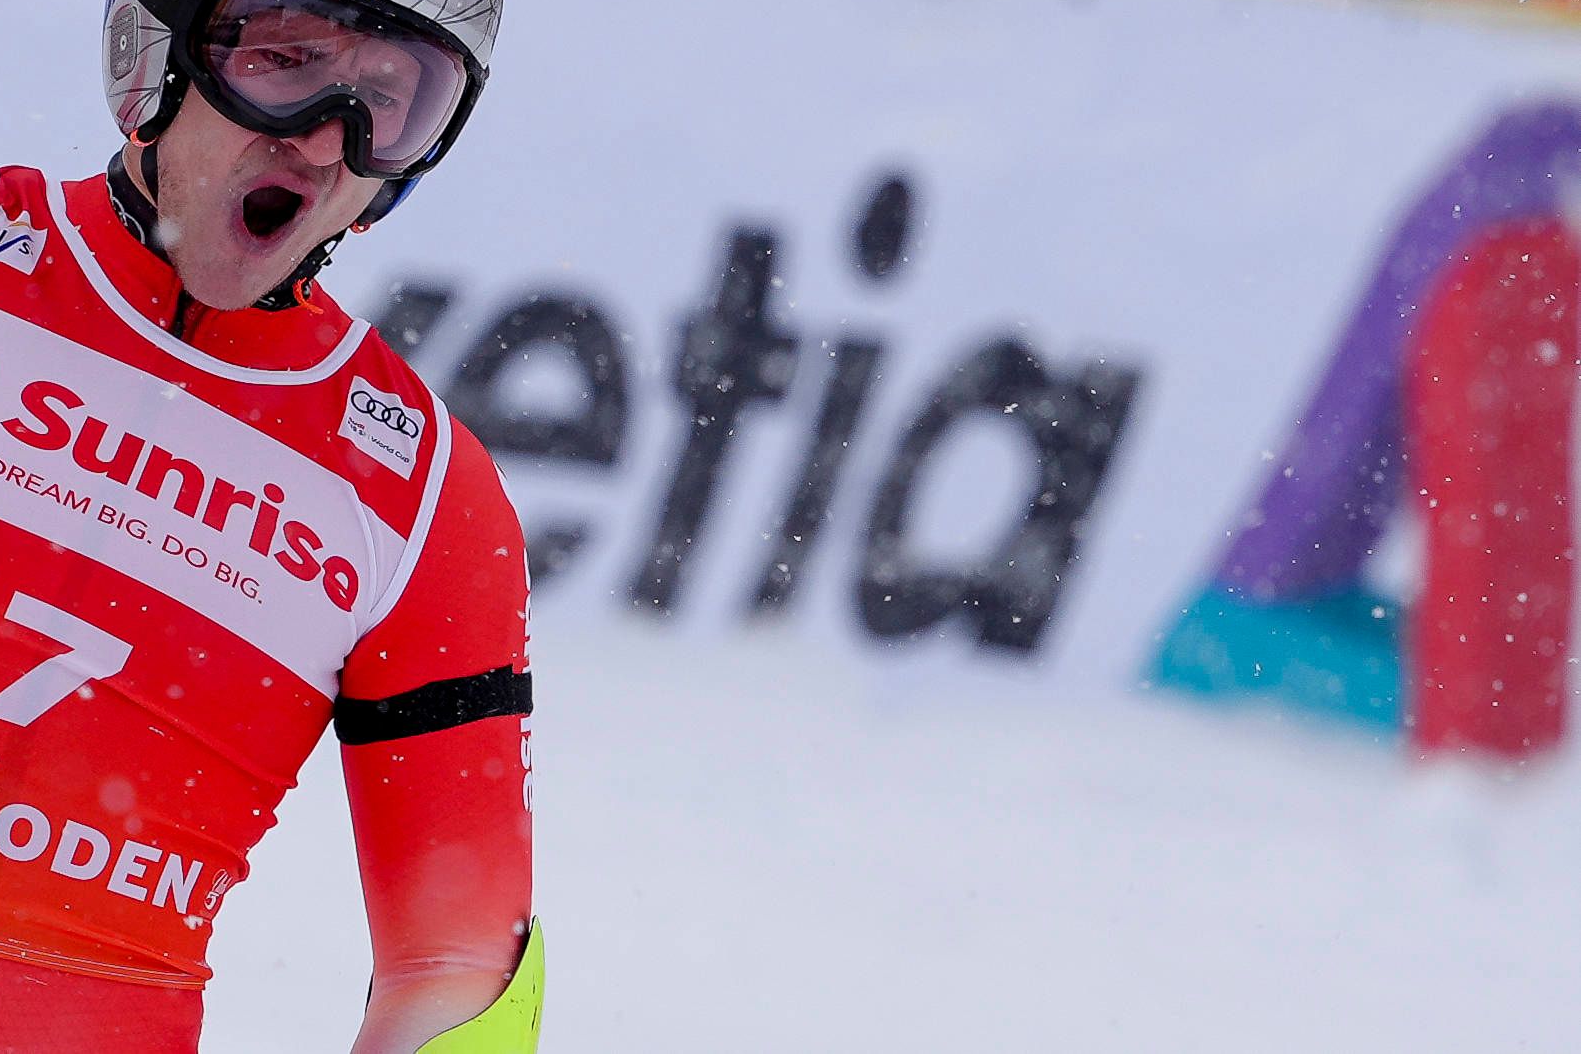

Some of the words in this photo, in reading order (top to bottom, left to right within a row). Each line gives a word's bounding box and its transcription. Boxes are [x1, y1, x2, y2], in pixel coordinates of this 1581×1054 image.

[0, 380, 359, 613] Sunrise
[96, 503, 153, 546] BIG.
[163, 533, 209, 569] DO
[213, 560, 264, 605] BIG.
